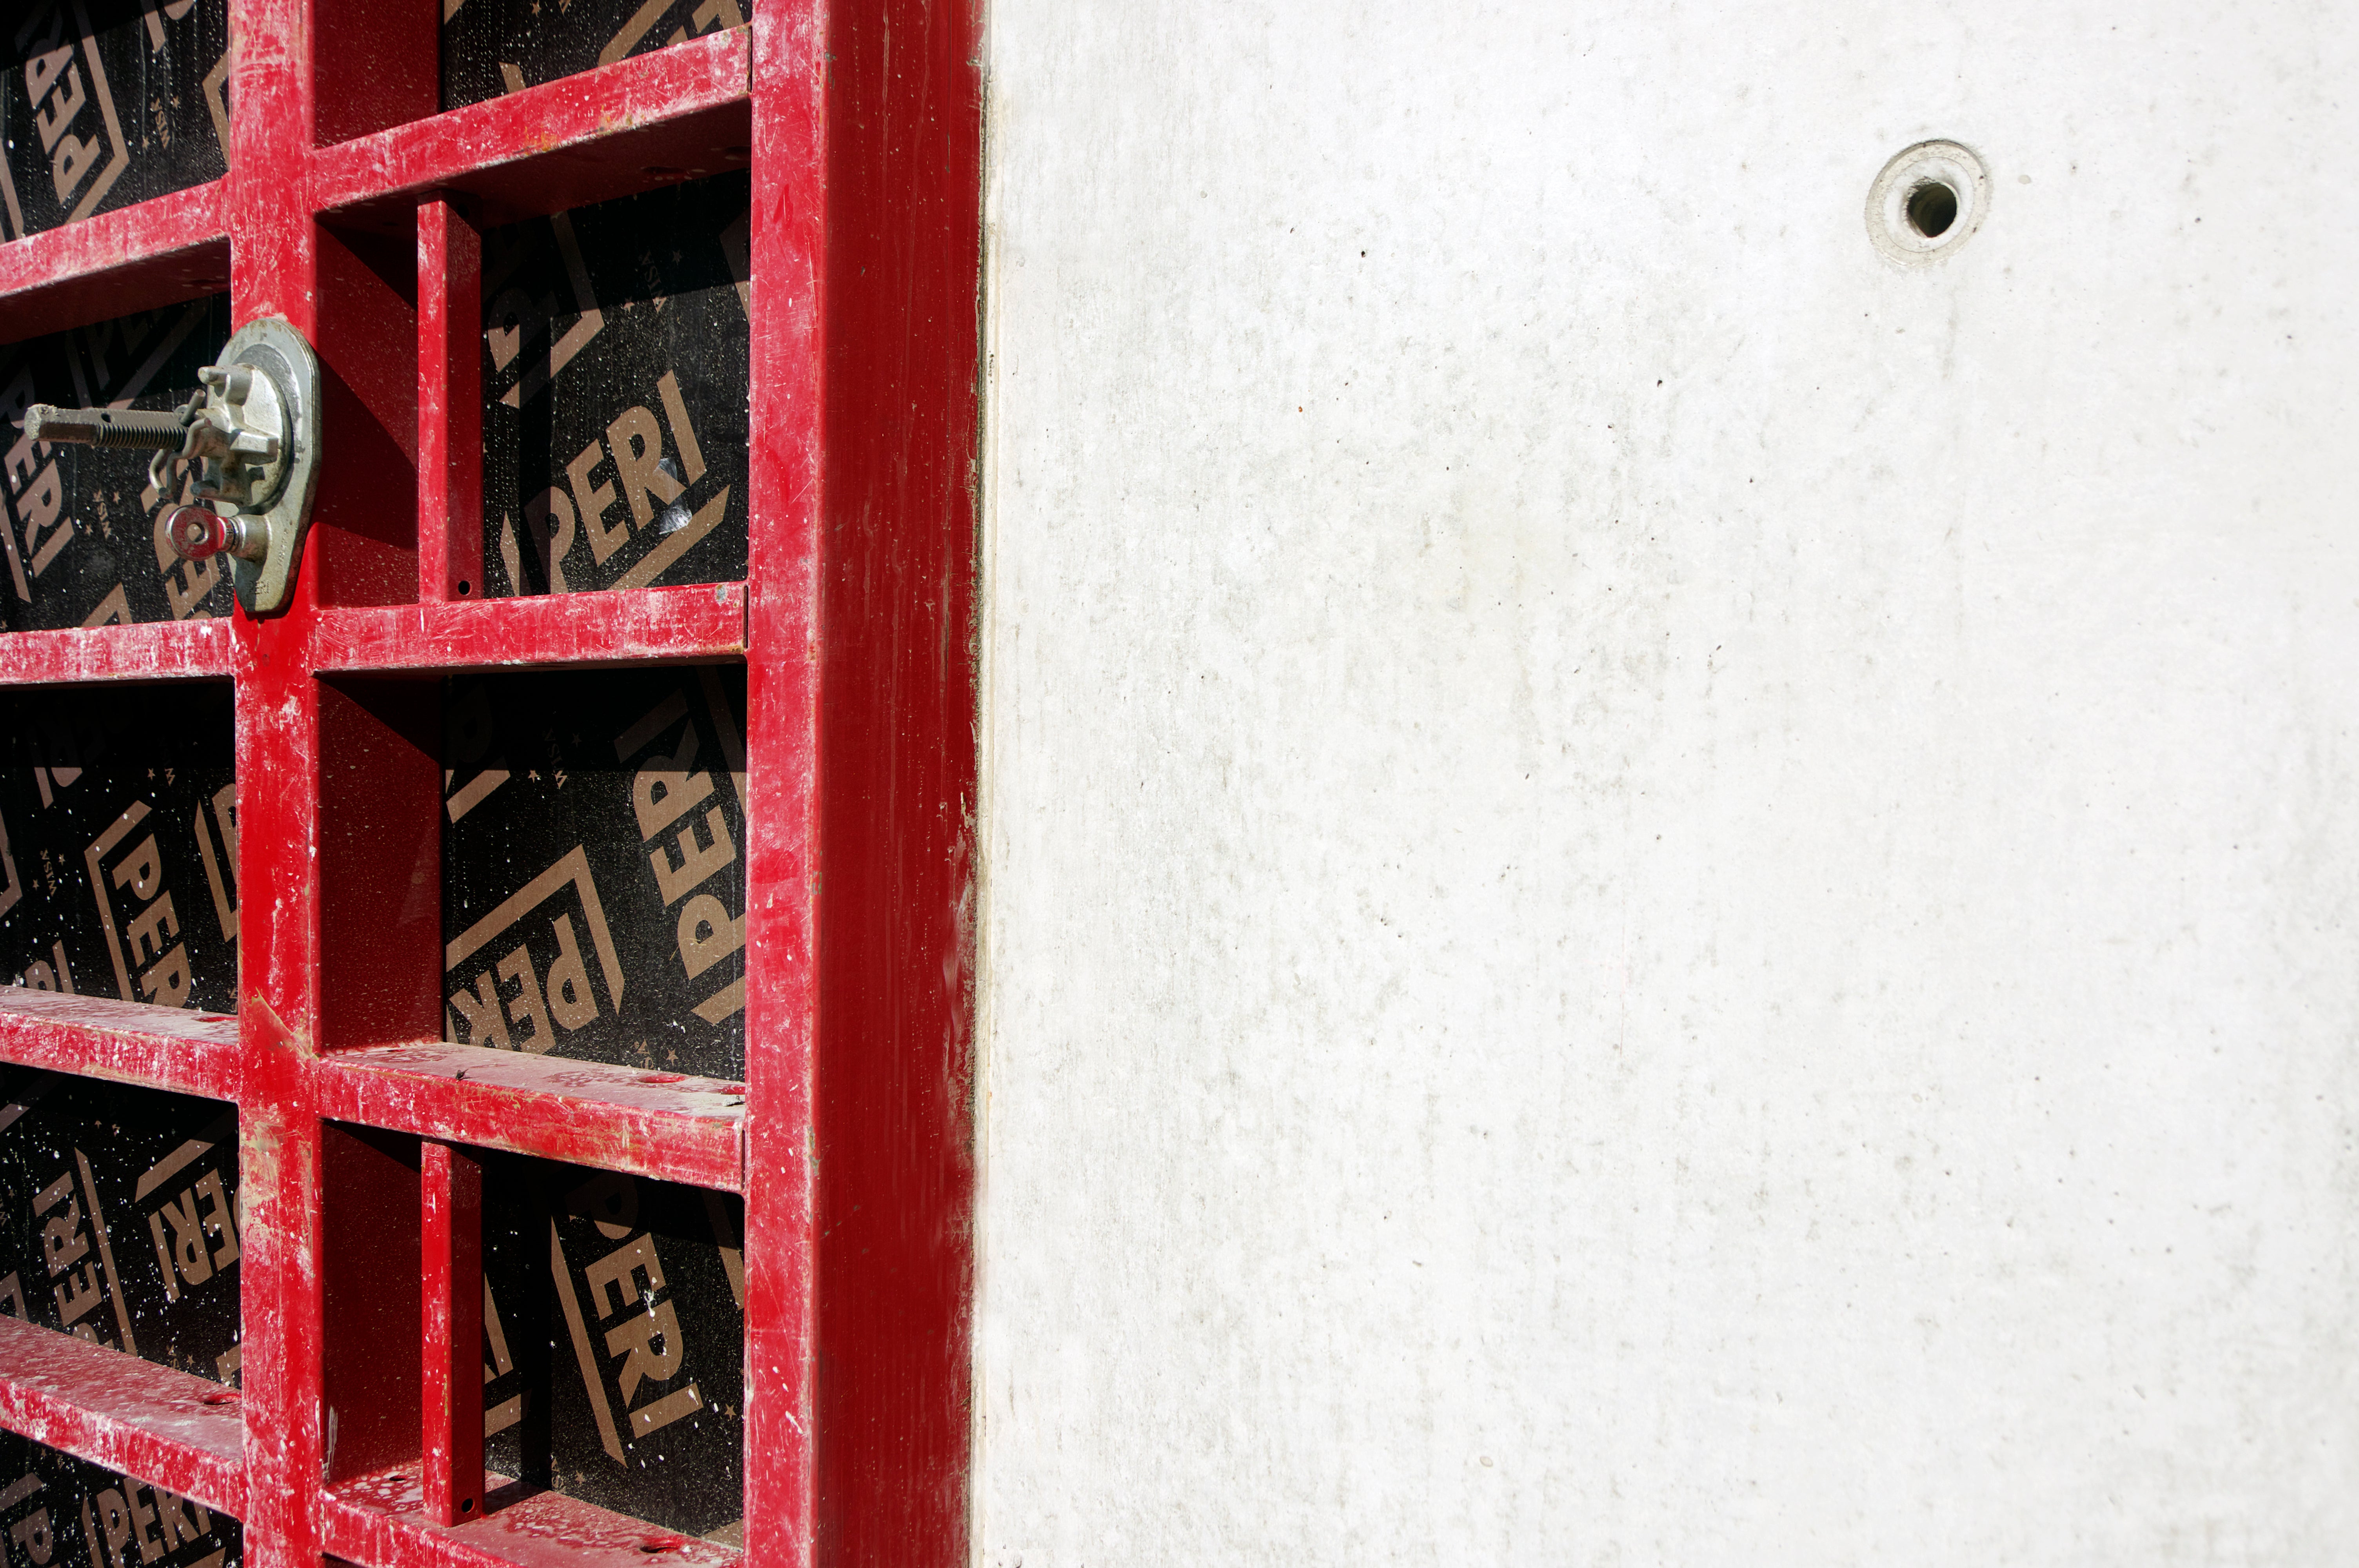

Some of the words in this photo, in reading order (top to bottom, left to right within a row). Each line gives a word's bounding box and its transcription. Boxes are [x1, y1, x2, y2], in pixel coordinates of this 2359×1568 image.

[642, 249, 667, 313] WISA
[524, 369, 706, 594] PERI
[40, 848, 57, 897] WISA
[614, 687, 746, 981] PERI
[565, 1170, 704, 1439] PERI
